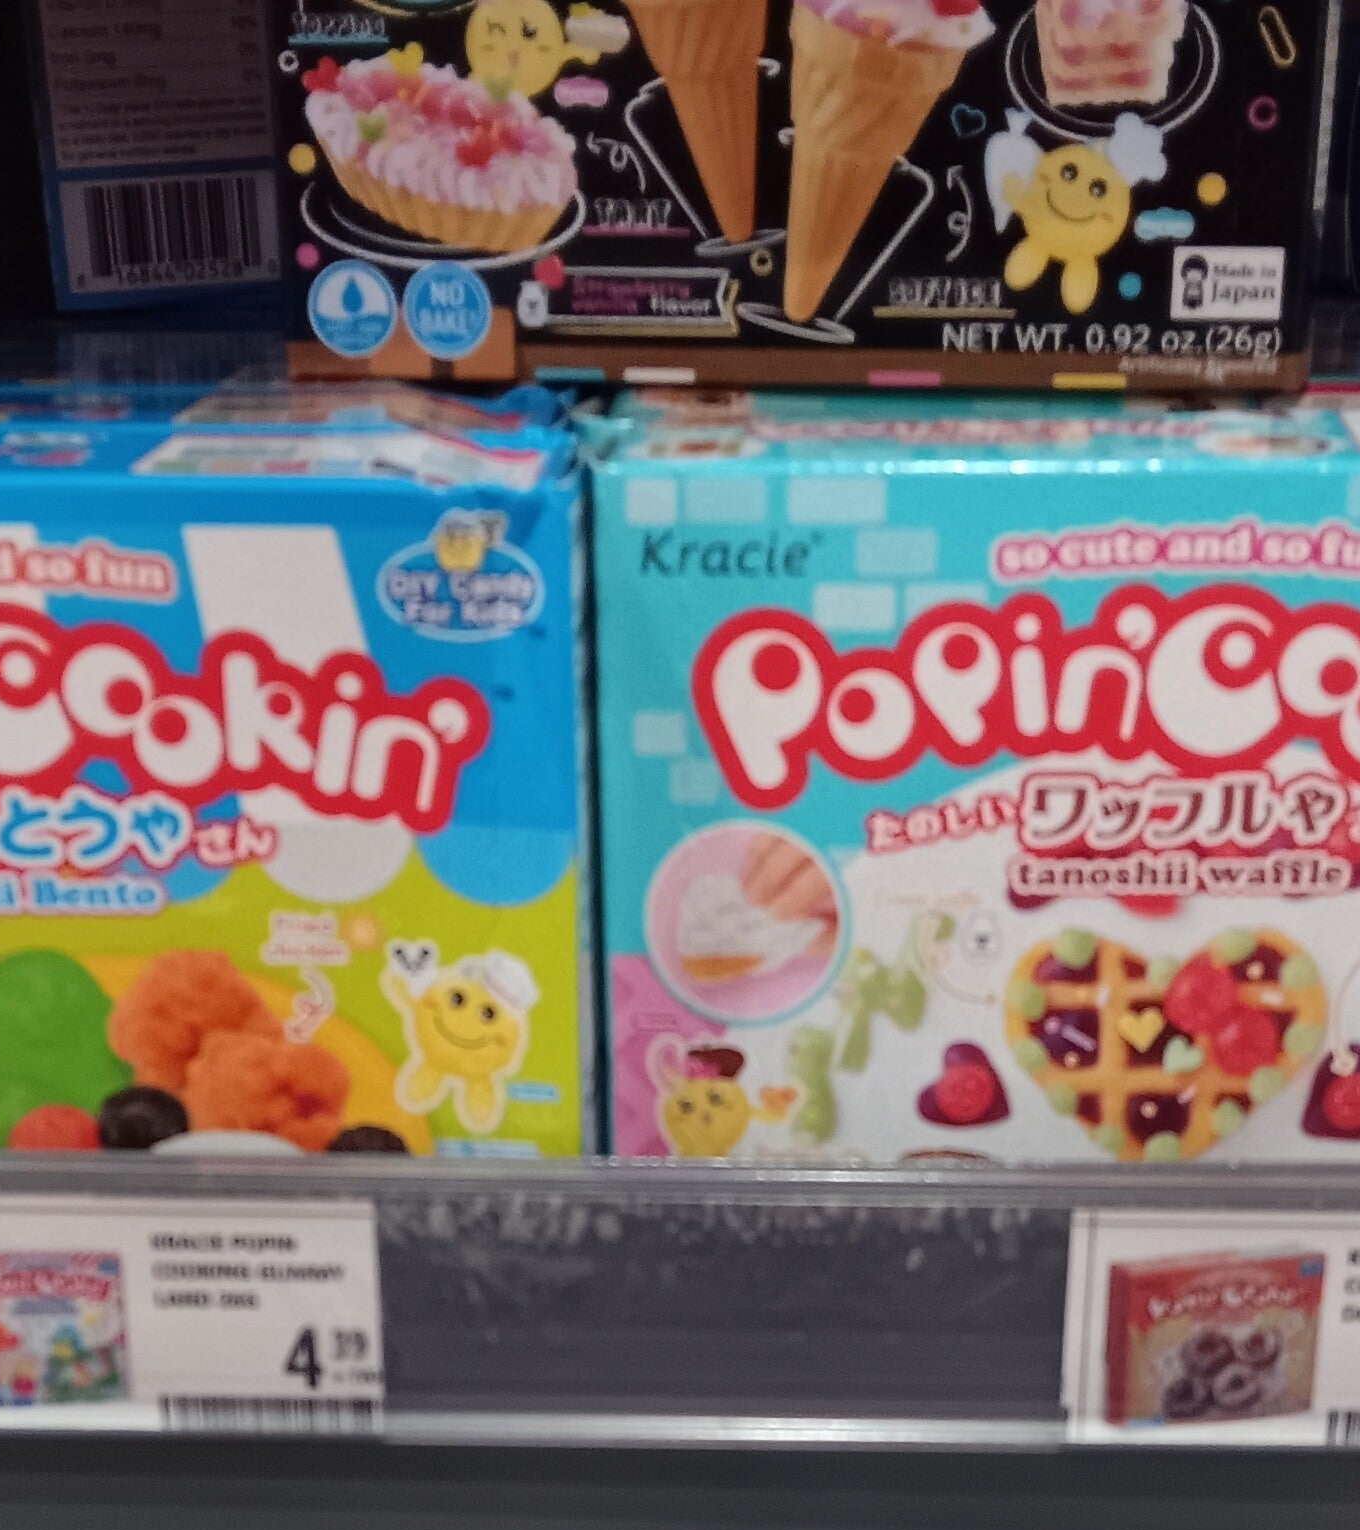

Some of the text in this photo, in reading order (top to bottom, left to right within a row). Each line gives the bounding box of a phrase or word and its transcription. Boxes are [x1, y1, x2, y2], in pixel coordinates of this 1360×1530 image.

[1210, 282, 1276, 304] Japan
[942, 323, 1004, 350] NET
[1013, 323, 1074, 350] WT.
[1086, 323, 1151, 351] 0.92
[26, 555, 75, 588] so
[83, 543, 171, 597] fun
[640, 532, 813, 578] Kracie
[999, 542, 1044, 575] so
[1059, 530, 1158, 568] cute
[1168, 522, 1251, 562] and
[1262, 535, 1312, 567] so
[866, 794, 1024, 854] たのしい
[1028, 774, 1344, 852] ワッフルや
[194, 824, 278, 864] さん
[32, 878, 159, 908] Bento
[1017, 854, 1347, 890] tanoshii waffle
[283, 1325, 323, 1389] 4
